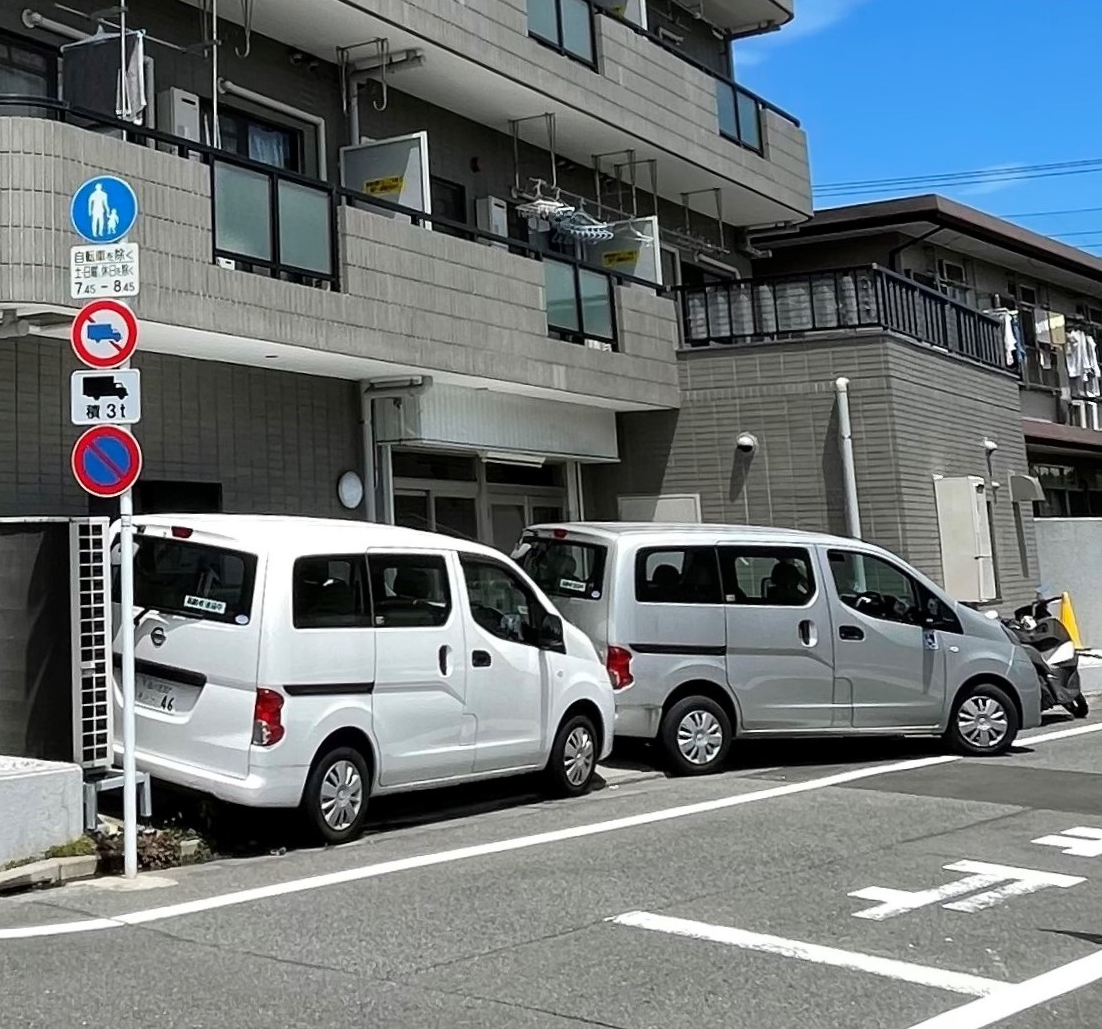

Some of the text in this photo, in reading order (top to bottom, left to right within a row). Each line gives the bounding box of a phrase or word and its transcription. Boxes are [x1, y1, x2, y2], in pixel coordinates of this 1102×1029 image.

[75, 248, 134, 263] 自転車を除く
